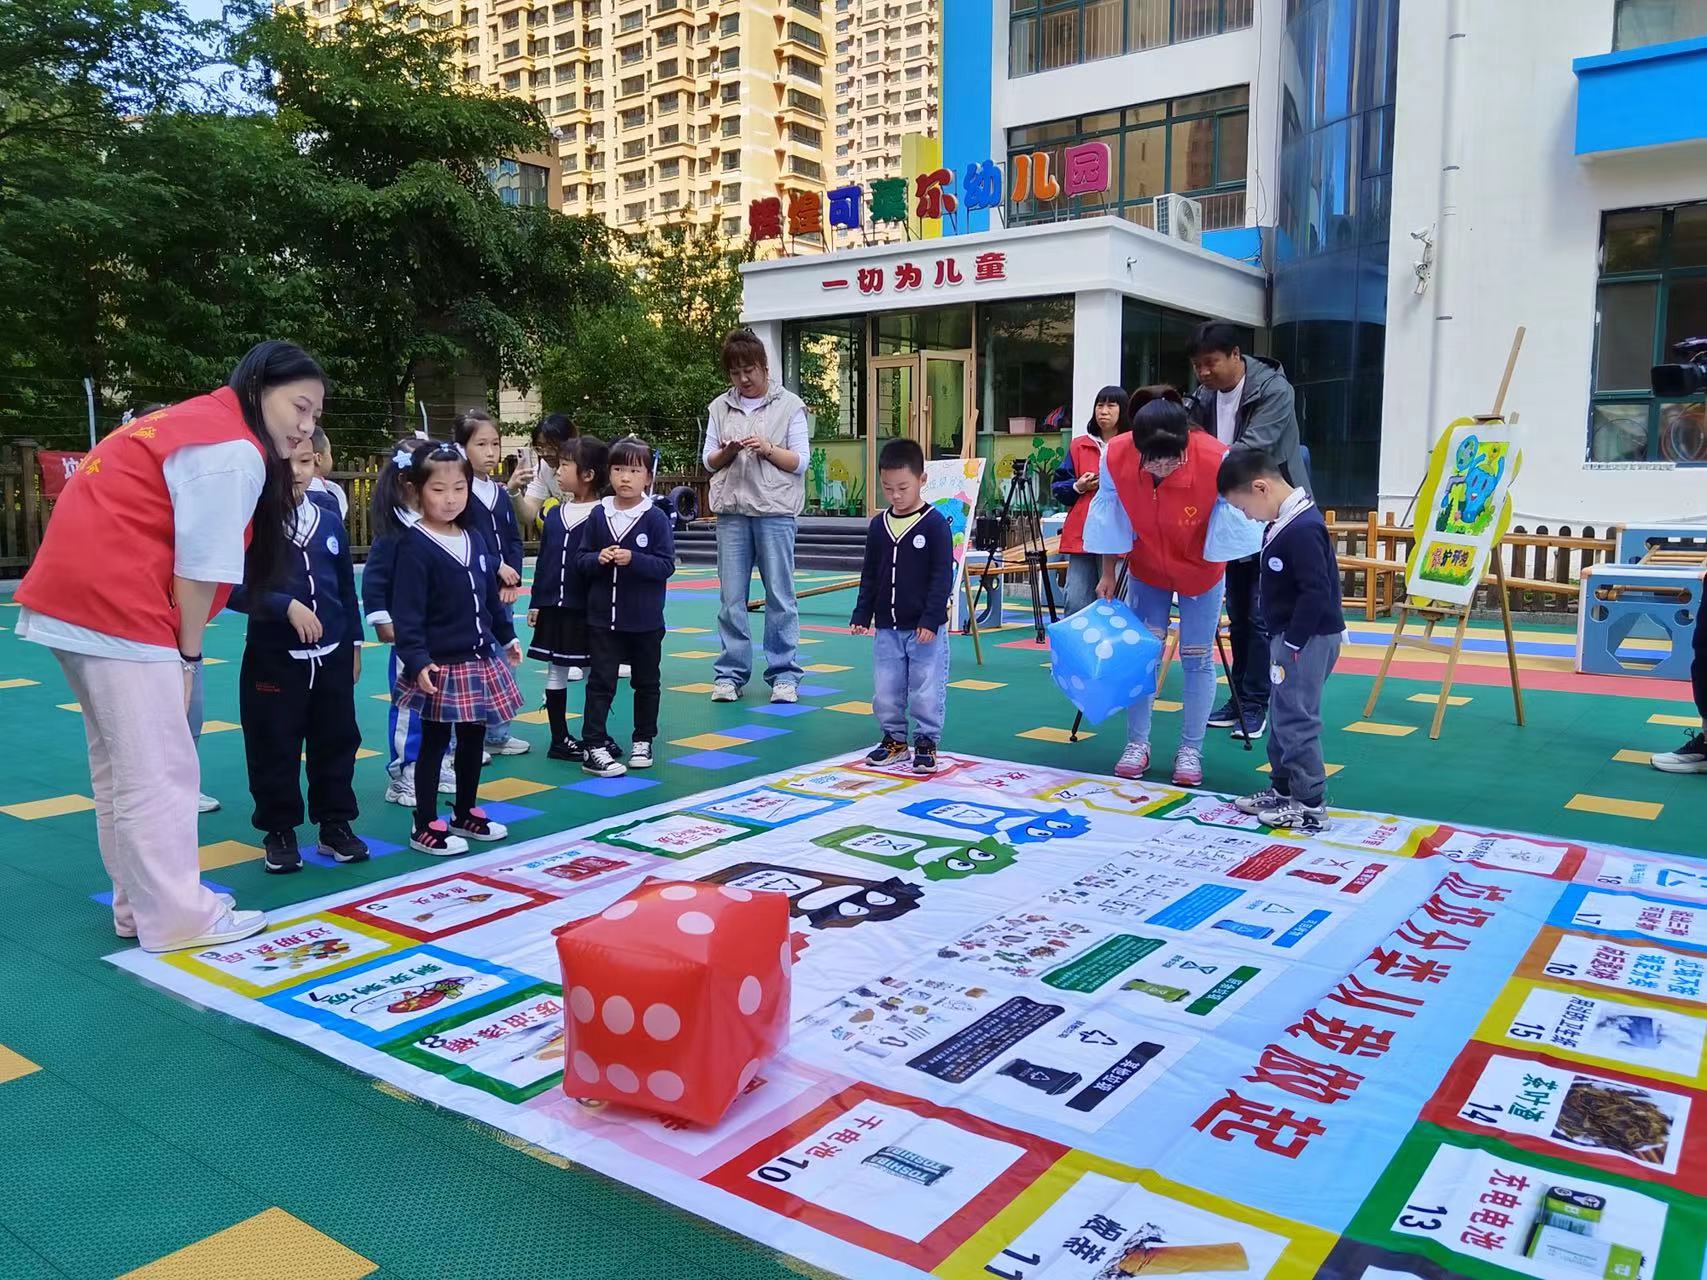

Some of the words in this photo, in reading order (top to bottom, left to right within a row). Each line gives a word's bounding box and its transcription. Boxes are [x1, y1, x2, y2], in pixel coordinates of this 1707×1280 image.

[821, 251, 1009, 295] 一切为儿童
[410, 886, 468, 905] 鱼骨头
[1597, 874, 1622, 885] 18
[365, 902, 389, 912] 5
[1575, 911, 1602, 926] 17
[216, 928, 333, 963] 过期药品
[1545, 959, 1578, 976] 16
[1586, 945, 1629, 981] 向后退3格
[1627, 954, 1667, 989] 规定分类
[1667, 958, 1705, 997] 垃圾不按
[308, 991, 331, 1003] 7
[326, 963, 443, 1005] 剩菜剩饭
[444, 1000, 562, 1054] 废油漆桶
[1190, 871, 1513, 1160] 垃圾分类从我做起
[1510, 1016, 1546, 1041] 15
[1551, 996, 1596, 1049] 用过的卫生纸
[418, 1034, 447, 1049] 8
[1093, 1058, 1141, 1092] 其他垃圾
[1460, 1095, 1504, 1124] 14
[1508, 1074, 1559, 1123] 茶叶渣
[804, 1115, 883, 1159] 干电池
[757, 1156, 810, 1183] 10
[1398, 1204, 1442, 1231] 13
[1460, 1169, 1531, 1251] 充电电池
[1062, 1213, 1129, 1265] 烟蒂
[984, 1248, 1041, 1280] 11
